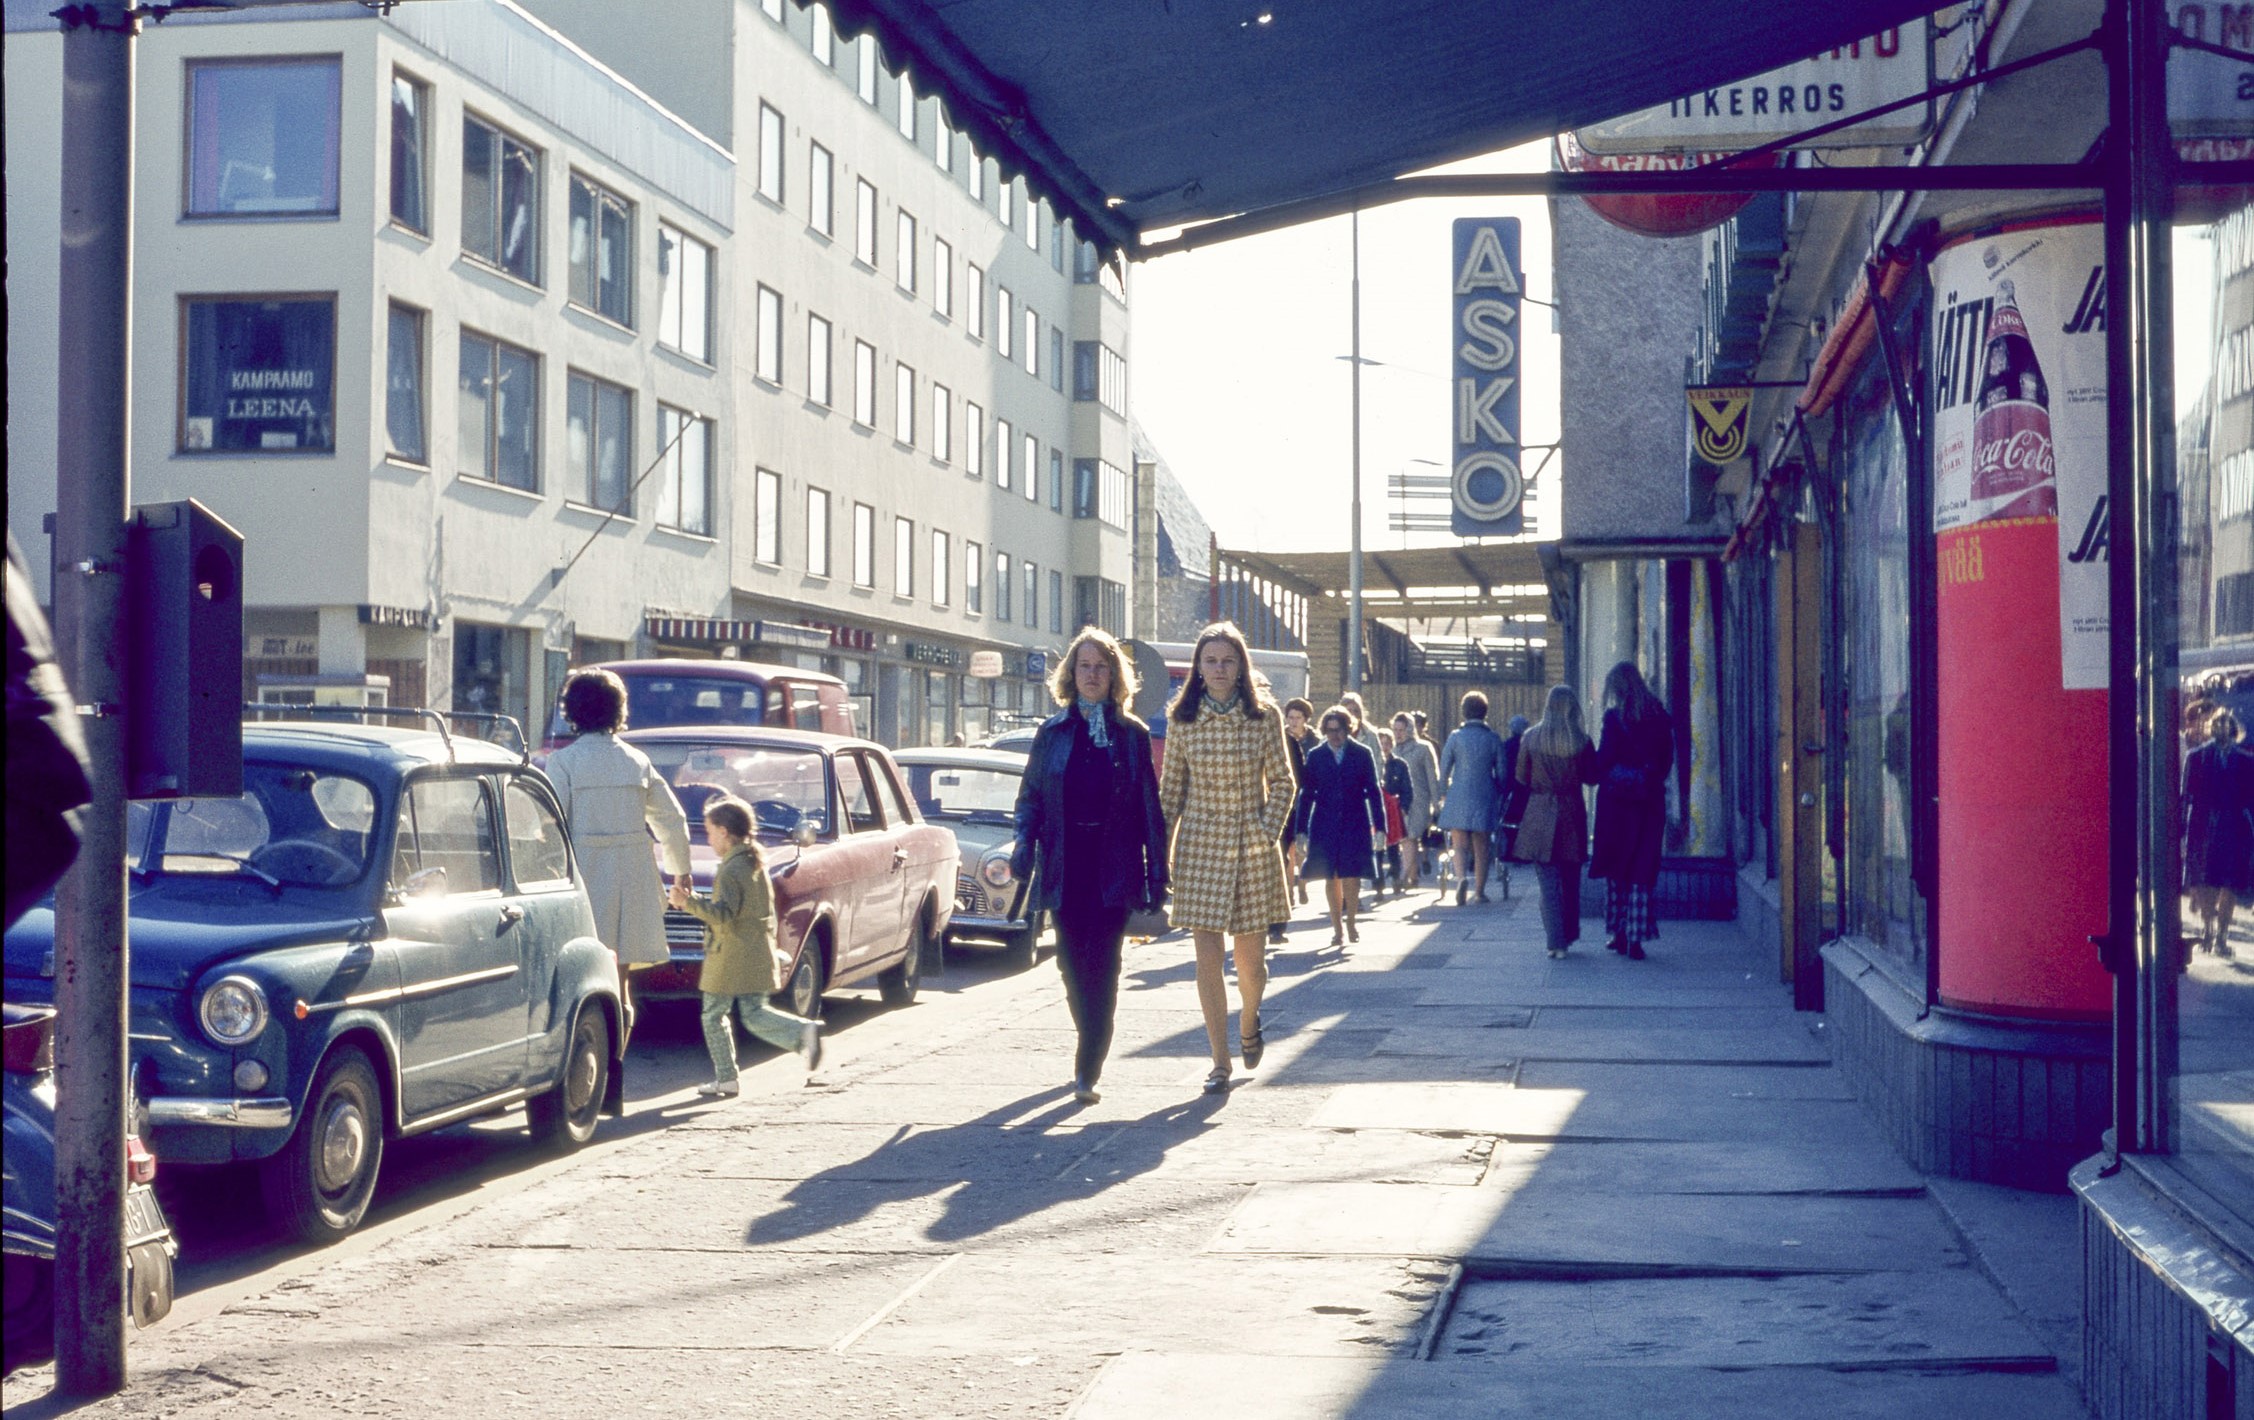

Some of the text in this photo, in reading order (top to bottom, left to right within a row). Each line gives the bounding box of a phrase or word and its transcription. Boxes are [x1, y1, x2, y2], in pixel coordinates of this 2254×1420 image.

[1704, 83, 1845, 118] KERROS
[231, 370, 314, 390] KAMPAAMO
[1450, 226, 1522, 522] ASKO
[228, 398, 316, 418] LEENA
